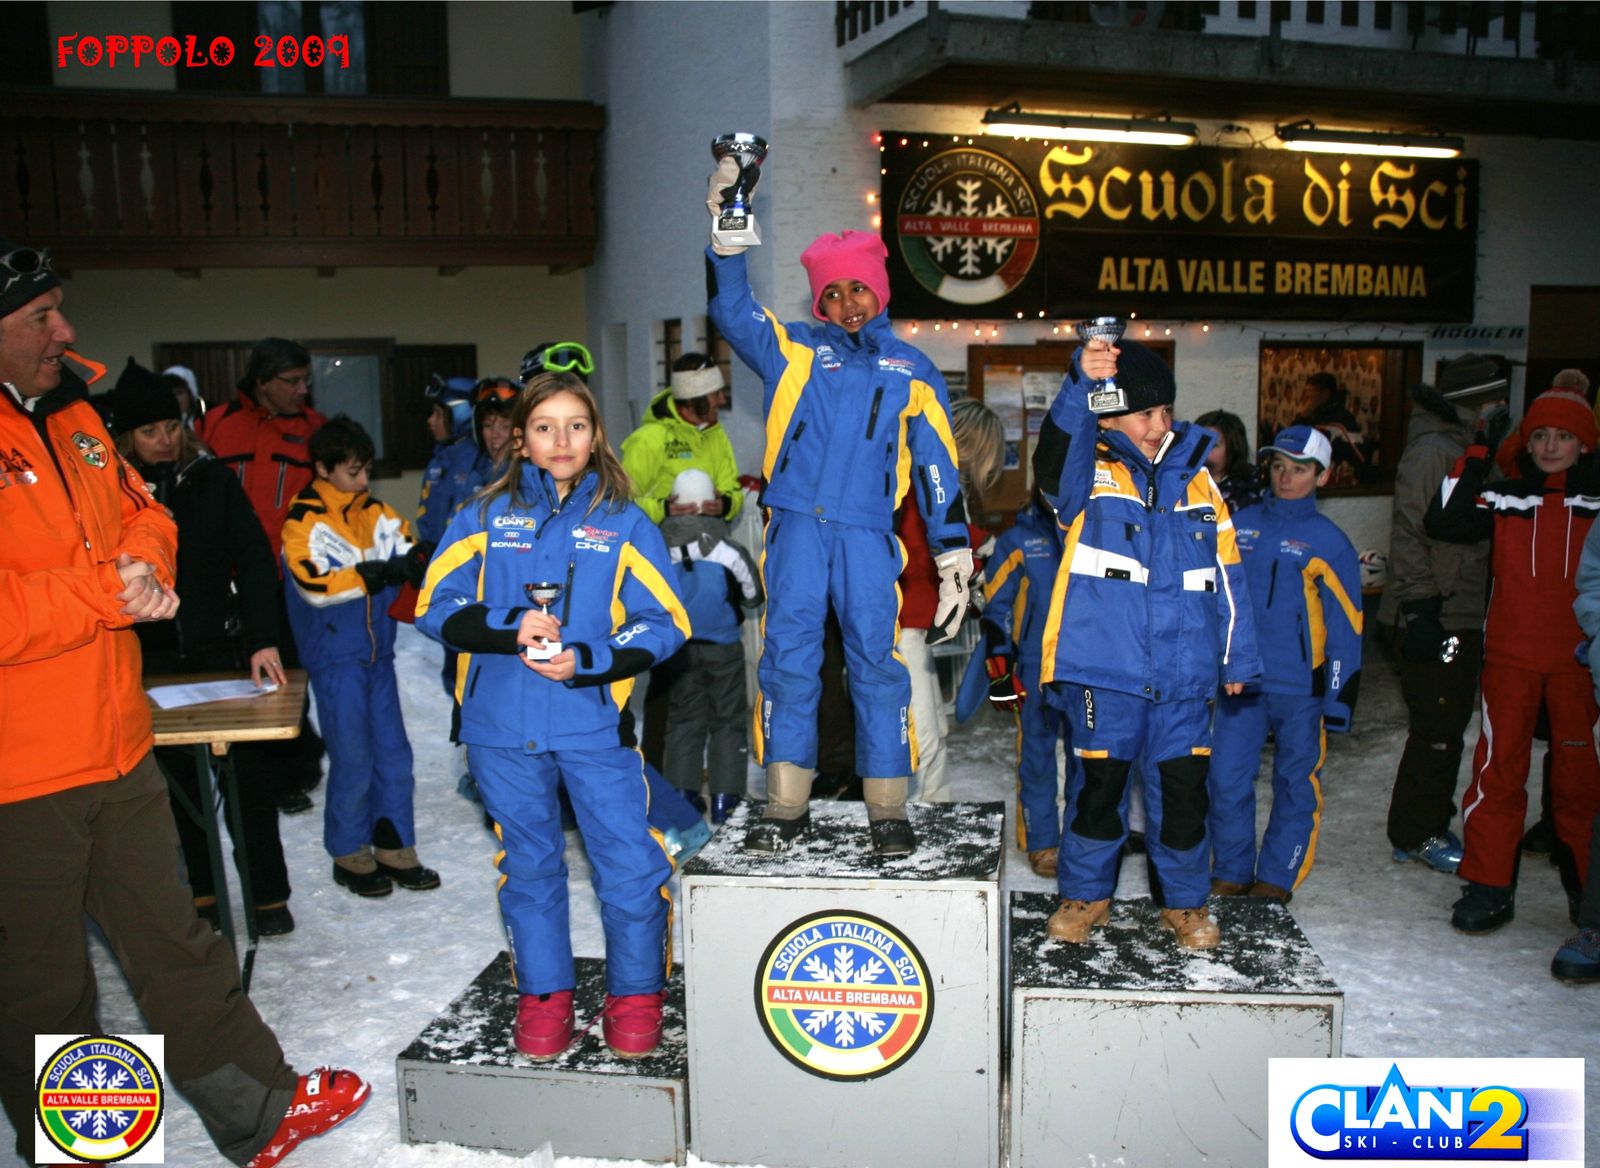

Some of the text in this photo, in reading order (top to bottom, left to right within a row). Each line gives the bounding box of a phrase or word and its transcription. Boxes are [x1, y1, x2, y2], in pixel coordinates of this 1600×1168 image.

[905, 154, 1033, 214] SCUOLA ITALIANA SCI
[1039, 146, 1468, 230] Scuola di Sci
[905, 221, 1033, 233] ALTA VALLE BREMBANA
[1098, 257, 1427, 297] ALTA VALLE BREMBANA
[1084, 689, 1094, 729] COLLE
[775, 923, 917, 981] SCUOLA ITALIANA SCI
[772, 988, 915, 1006] ALTA VALLE BREMBANA
